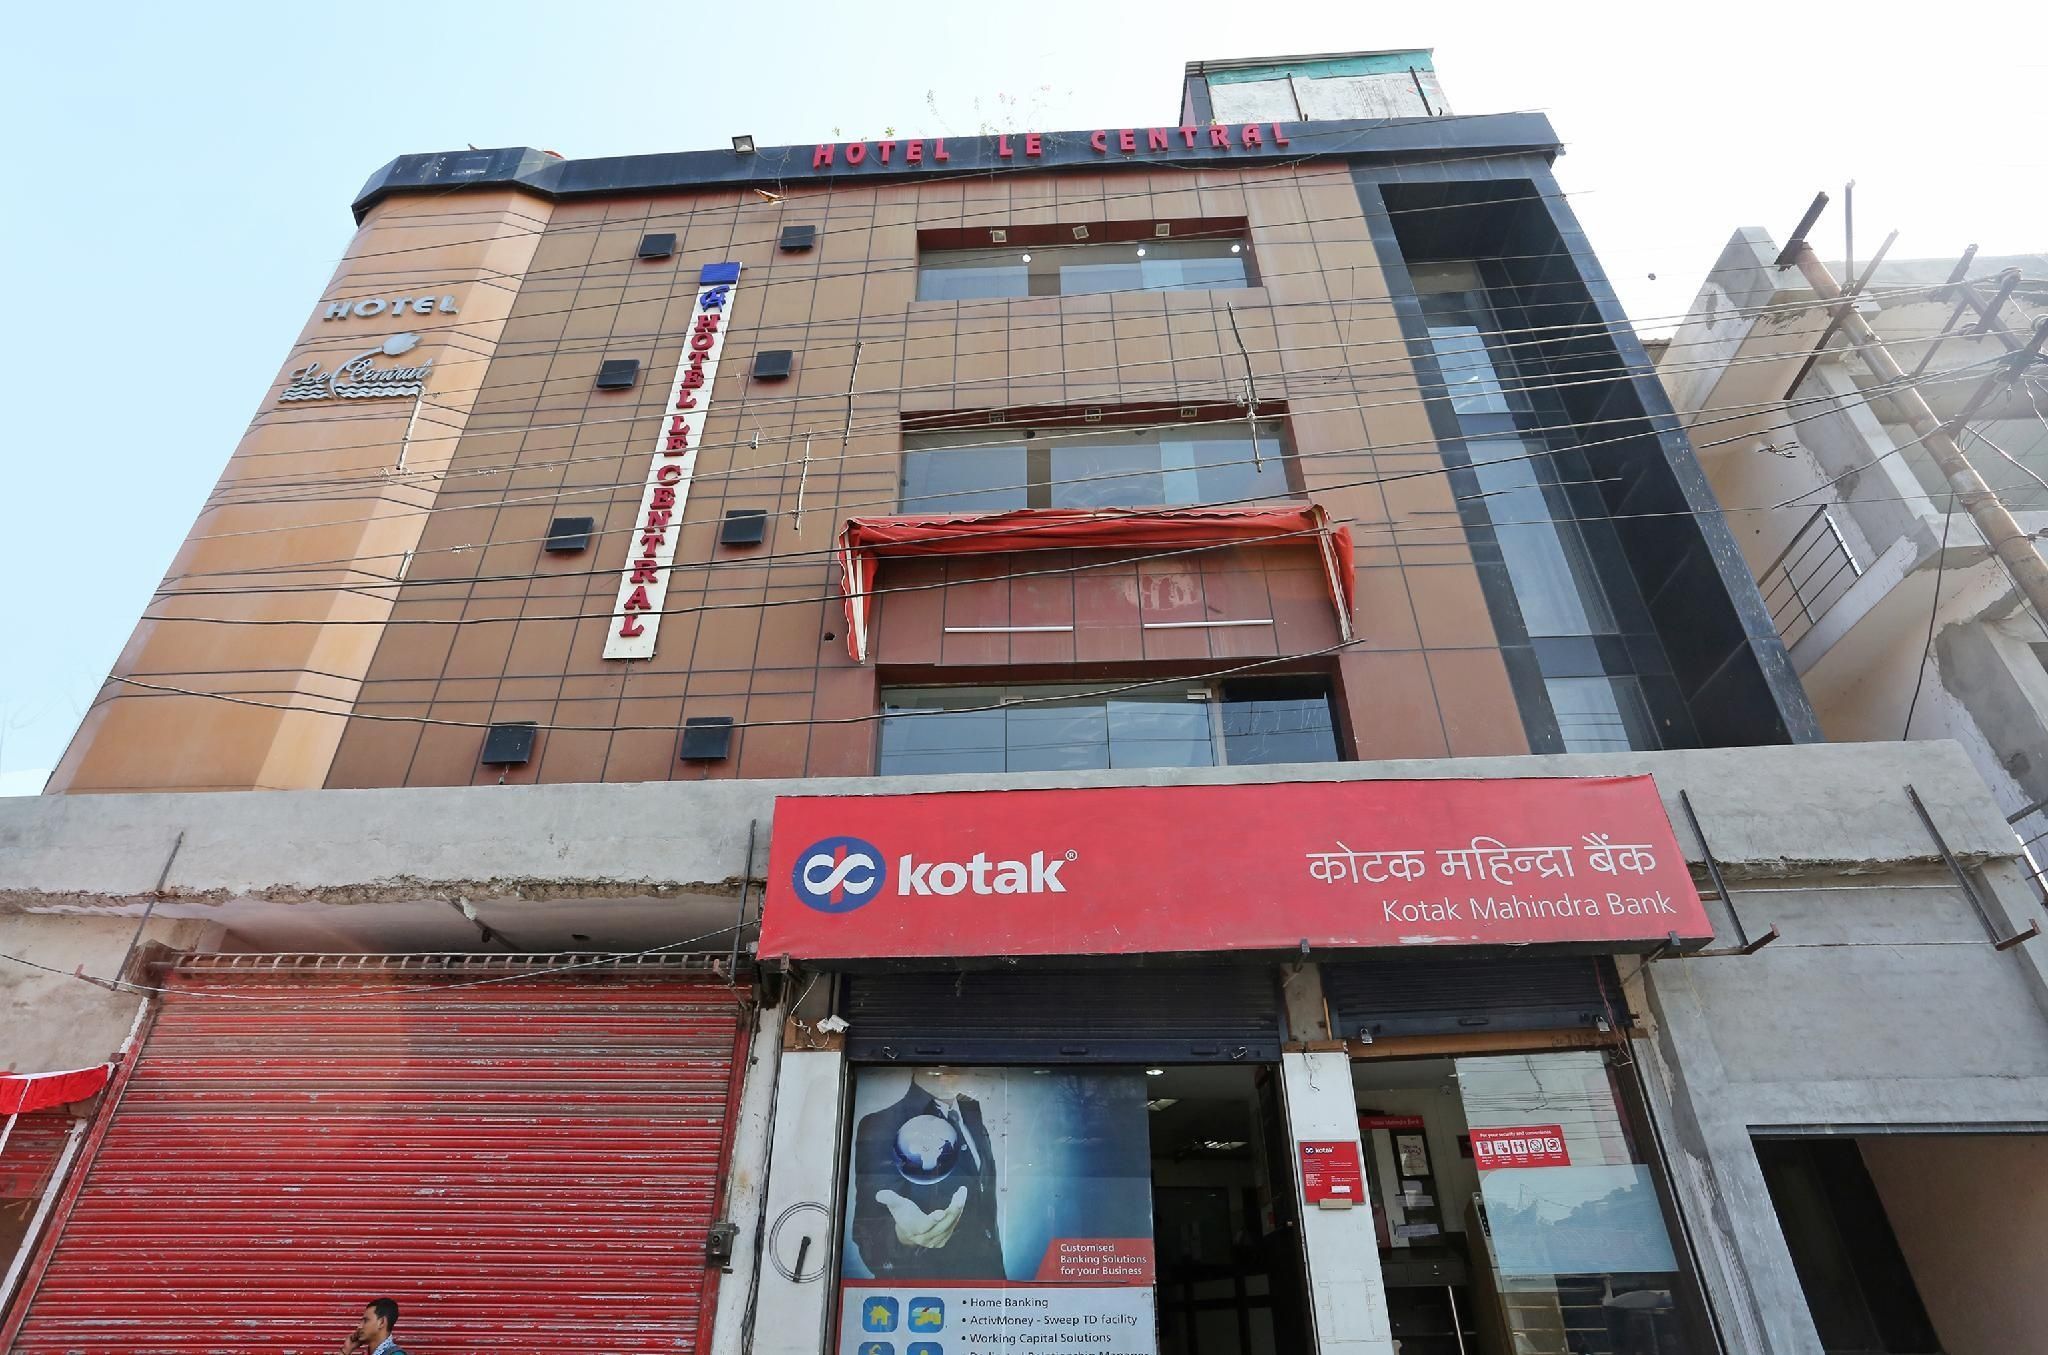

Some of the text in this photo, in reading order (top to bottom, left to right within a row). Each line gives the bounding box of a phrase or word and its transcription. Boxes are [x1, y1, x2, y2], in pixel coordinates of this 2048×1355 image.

[813, 121, 1291, 169] HOTEL LE CENTRAL
[322, 295, 460, 322] HOTEL
[289, 361, 332, 386] Le
[618, 313, 722, 637] HOTEL LE CENTRAL
[1305, 832, 1657, 886] कोटक महिन्द्रा बैंक
[1382, 890, 1678, 923] Kotak Mahindra Bank
[1060, 1243, 1115, 1253] Customised
[1060, 1254, 1147, 1266] Banking Solutions
[1060, 1265, 1142, 1277] for your Business
[970, 1297, 1049, 1309] Home Banking
[970, 1315, 1034, 1327] ActivMoney
[1044, 1315, 1080, 1327] Sweep
[1083, 1315, 1098, 1325] TD
[1101, 1313, 1138, 1326] facility
[969, 1332, 1112, 1346] Working Capital Solutions
